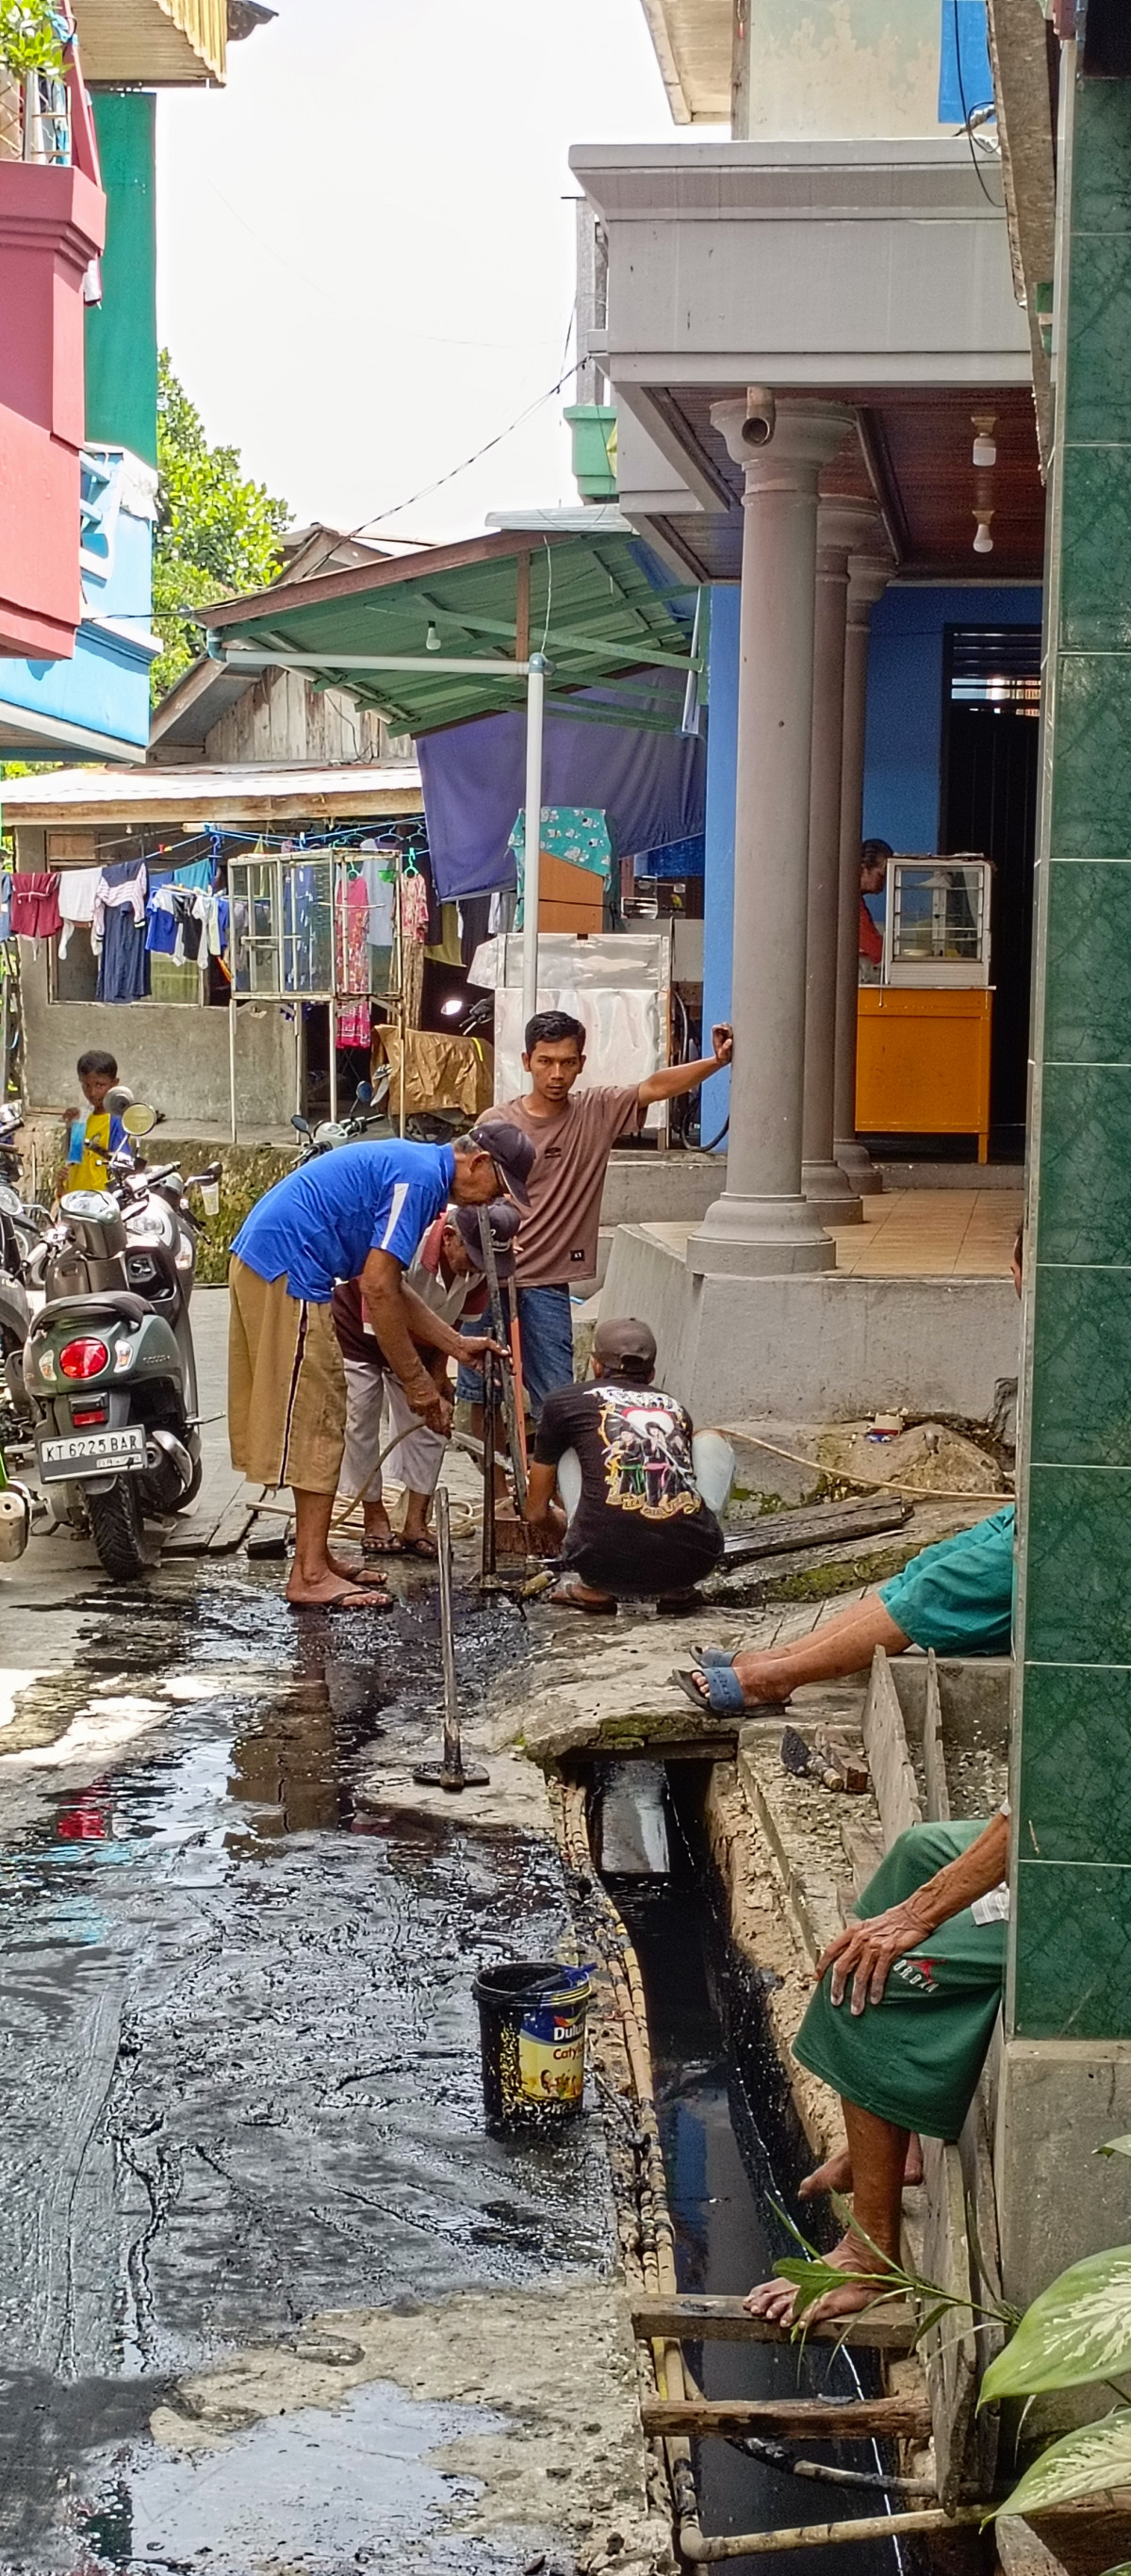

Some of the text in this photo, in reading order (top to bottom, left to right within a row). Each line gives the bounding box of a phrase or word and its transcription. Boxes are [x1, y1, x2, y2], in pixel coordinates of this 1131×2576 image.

[46, 1435, 137, 1461] KT 6225 BAR
